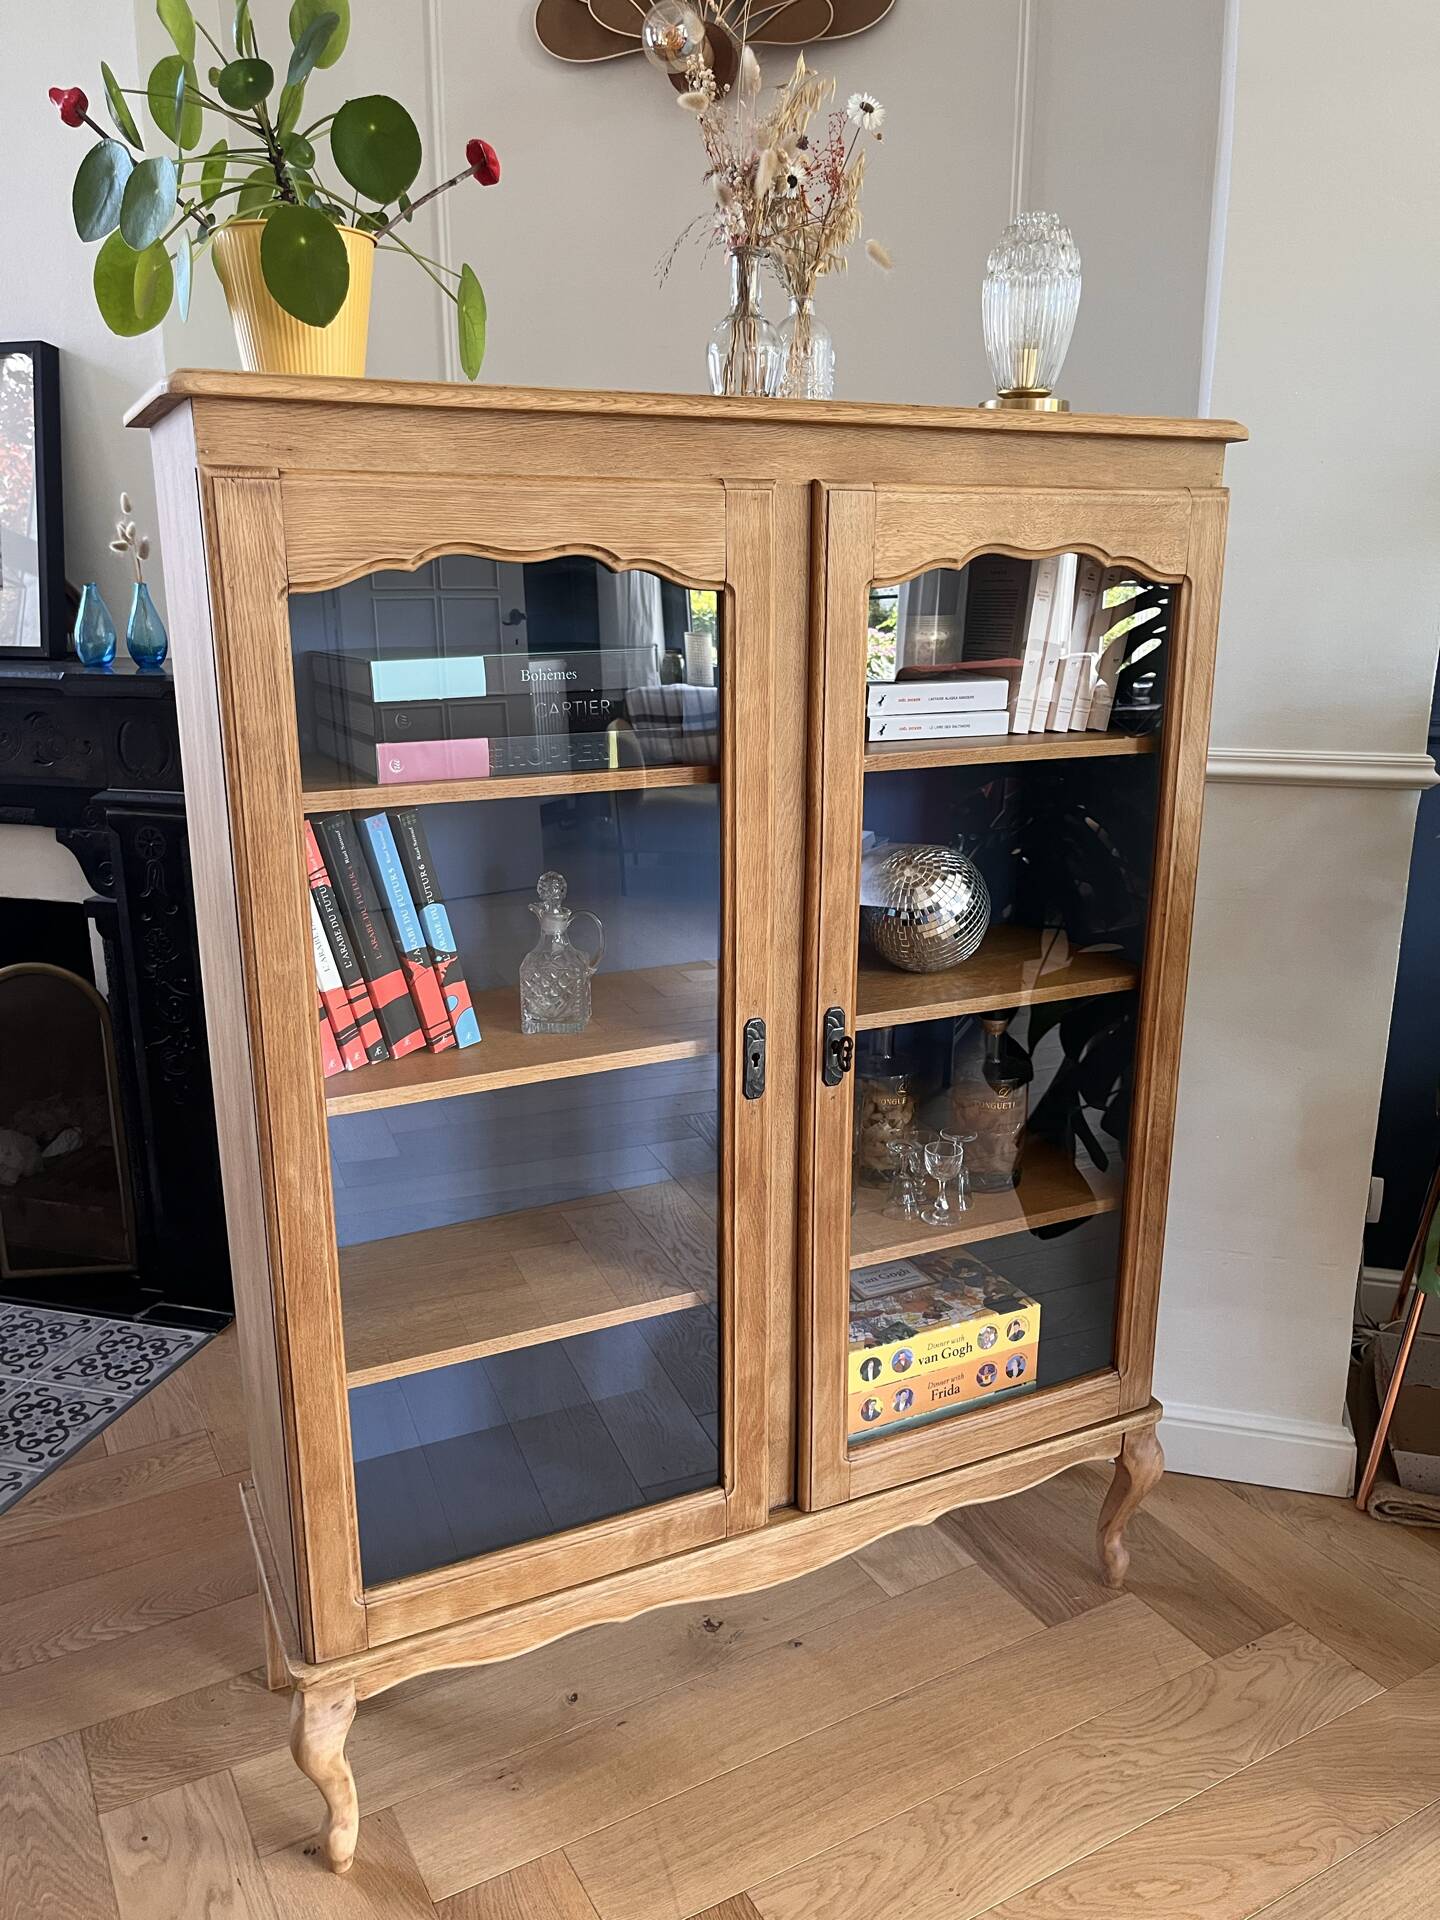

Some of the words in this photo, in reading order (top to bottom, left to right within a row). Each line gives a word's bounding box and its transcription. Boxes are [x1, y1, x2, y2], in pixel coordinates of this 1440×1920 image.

[520, 668, 578, 681] Bohèmes
[535, 699, 610, 717] CARTIER
[508, 743, 611, 767] HOPPER
[342, 850, 350, 864] Riad
[348, 872, 363, 904] FUTUR
[390, 874, 405, 906] FUTUR
[420, 870, 435, 903] FUTUR
[318, 879, 333, 913] FUTUR
[329, 914, 339, 929] DU
[360, 907, 369, 920] DU
[400, 909, 409, 924] DU
[430, 906, 439, 920] DU
[334, 928, 352, 968] L'ARABE
[366, 922, 383, 960] L'ARABE
[406, 926, 423, 965] L'ARABE
[434, 922, 450, 961] L'ARABE
[858, 1276, 879, 1286] van
[879, 1268, 911, 1280] Gogh
[927, 1339, 950, 1351] Dinner
[950, 1334, 965, 1345] with
[918, 1353, 938, 1366] van
[941, 1342, 973, 1358] Gogh
[927, 1379, 950, 1390] Dinner
[950, 1372, 965, 1384] with
[931, 1384, 961, 1401] Frida
